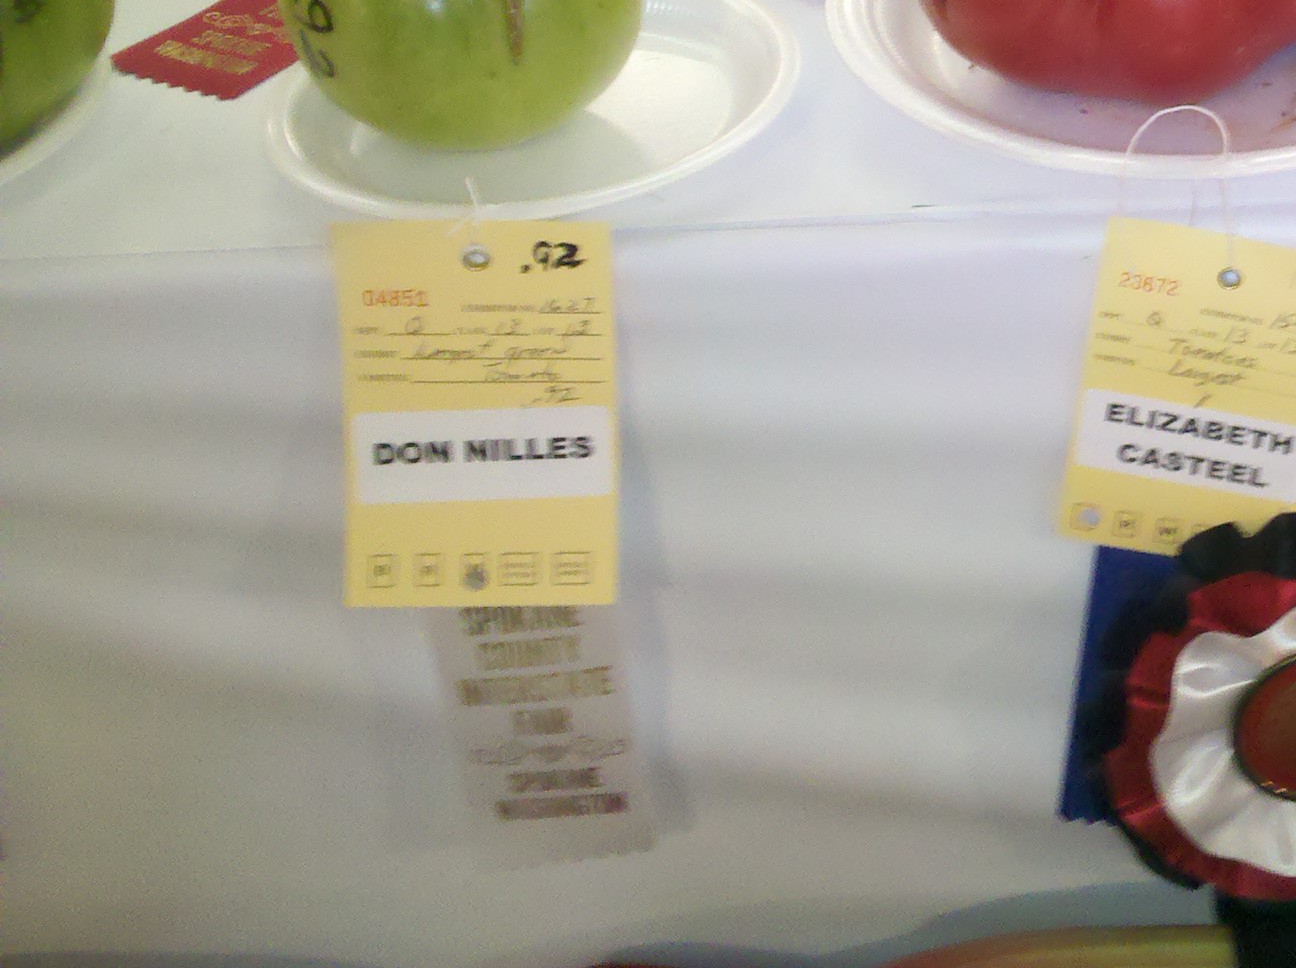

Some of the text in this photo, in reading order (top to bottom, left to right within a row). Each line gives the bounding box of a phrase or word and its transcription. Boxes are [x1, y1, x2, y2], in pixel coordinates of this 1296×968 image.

[372, 436, 595, 466] DON NILLES
[1116, 443, 1268, 488] CASTEEL
